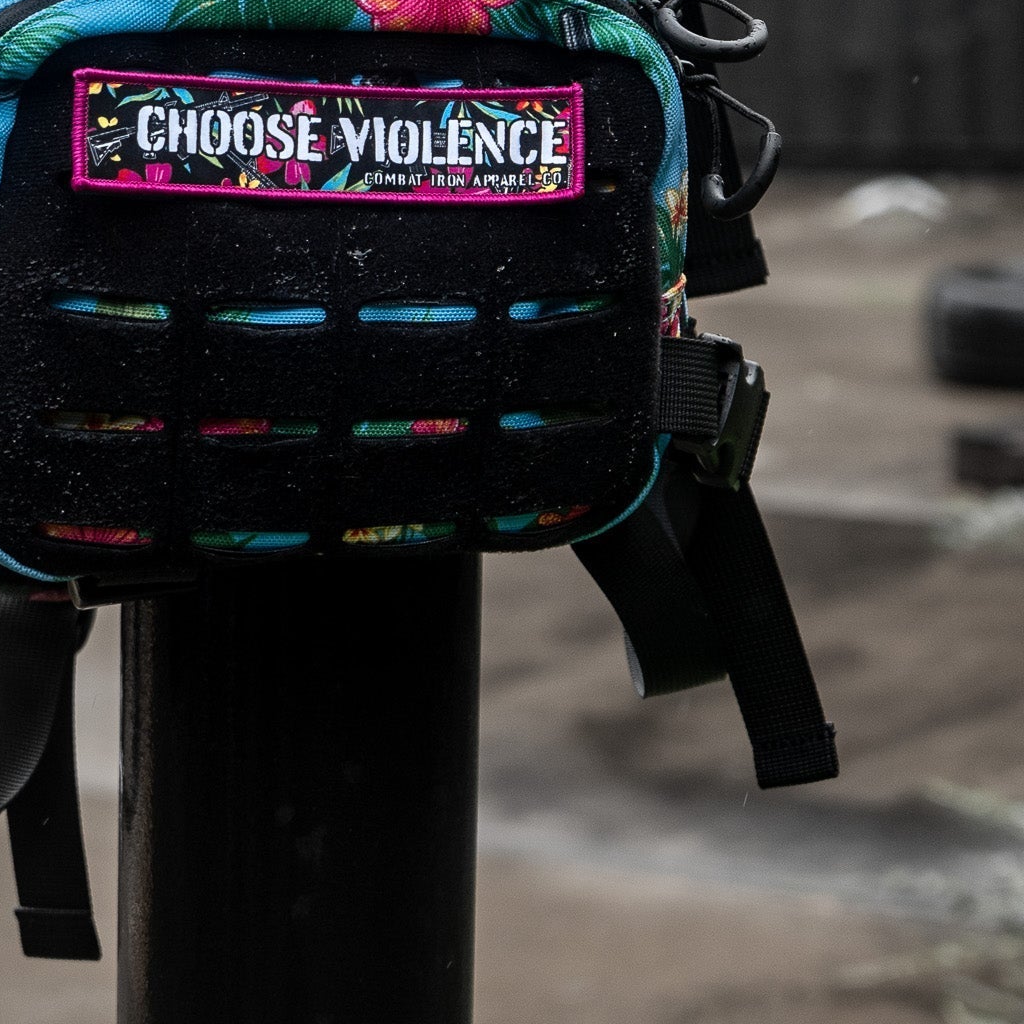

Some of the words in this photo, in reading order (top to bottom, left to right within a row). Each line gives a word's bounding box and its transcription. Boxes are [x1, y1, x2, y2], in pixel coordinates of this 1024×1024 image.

[136, 105, 322, 162] CHOOSE
[337, 116, 567, 166] VIOLENCE
[364, 172, 422, 187] COMBAT
[430, 173, 465, 187] IRON
[473, 173, 535, 187] APPAREL
[542, 172, 567, 186] CO.
